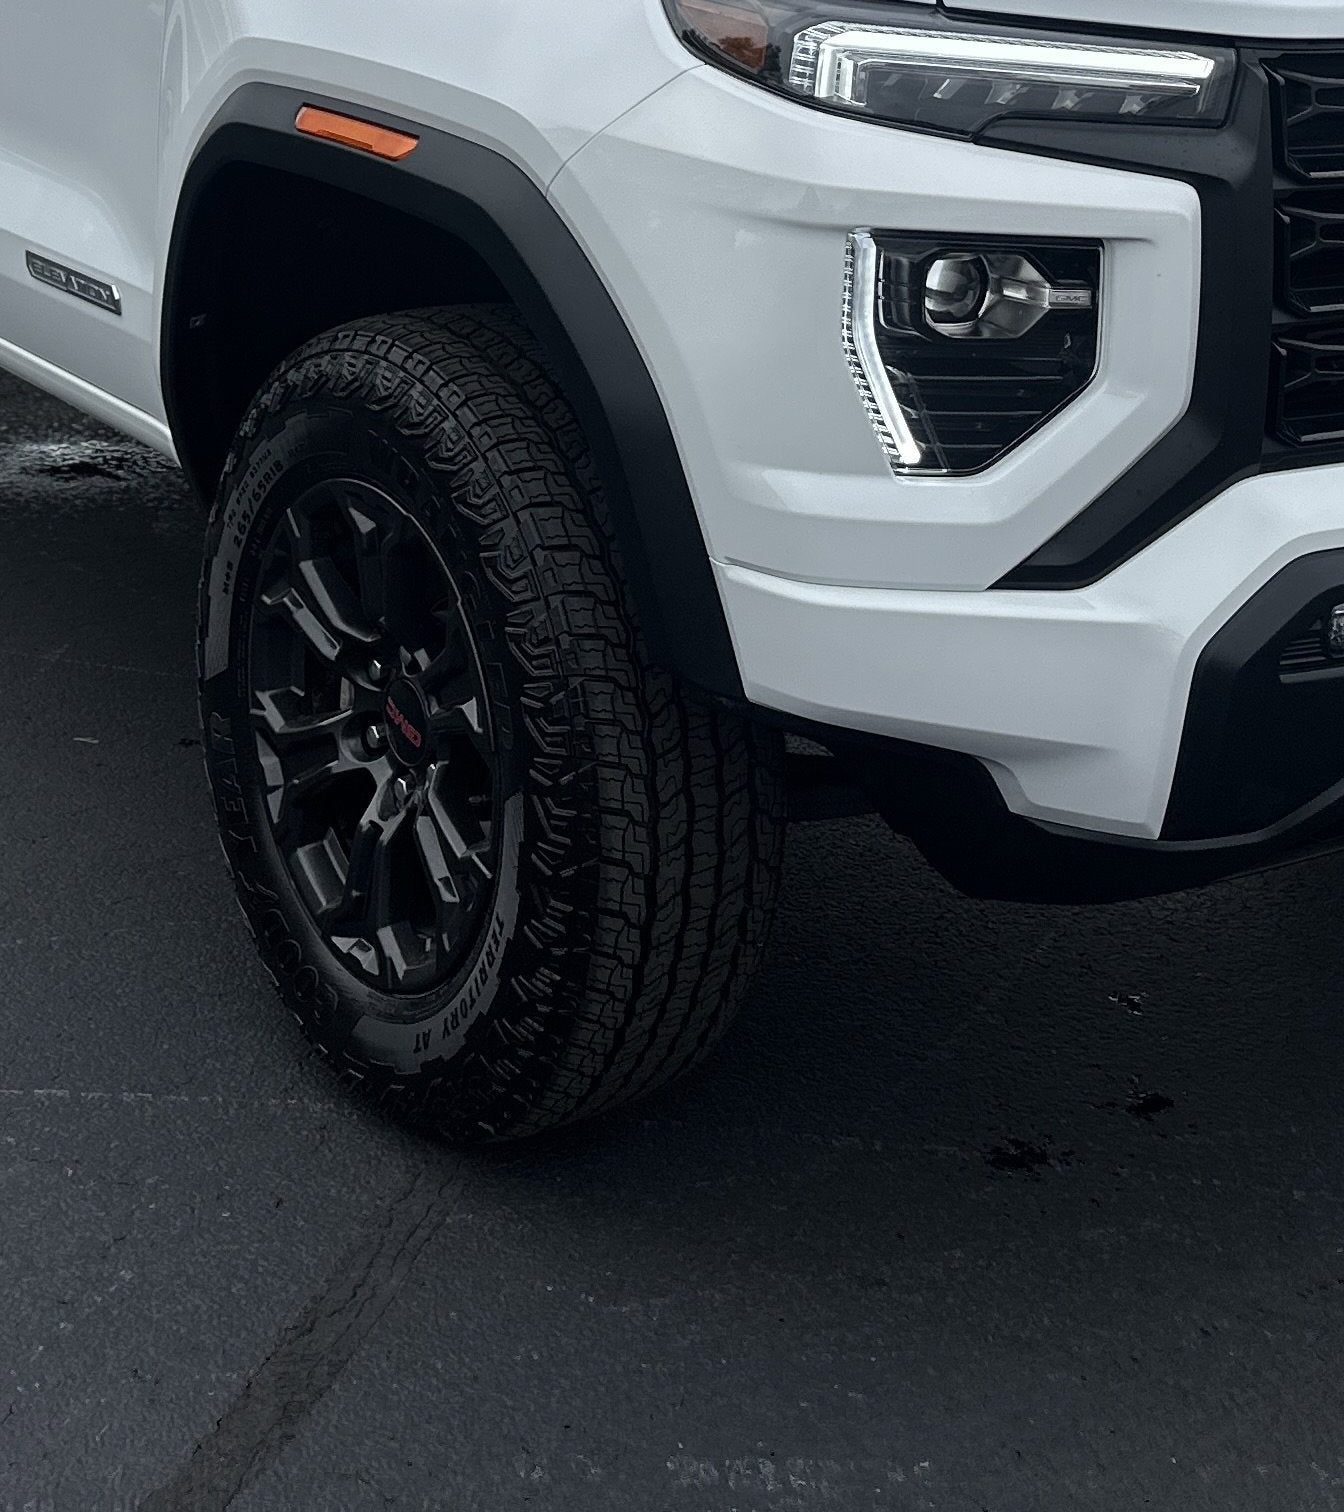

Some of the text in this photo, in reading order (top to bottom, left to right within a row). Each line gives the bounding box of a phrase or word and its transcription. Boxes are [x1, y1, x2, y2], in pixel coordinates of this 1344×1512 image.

[233, 460, 284, 548] 265/65R18
[385, 695, 422, 748] GMC
[412, 914, 505, 1054] TERRITORY AT
